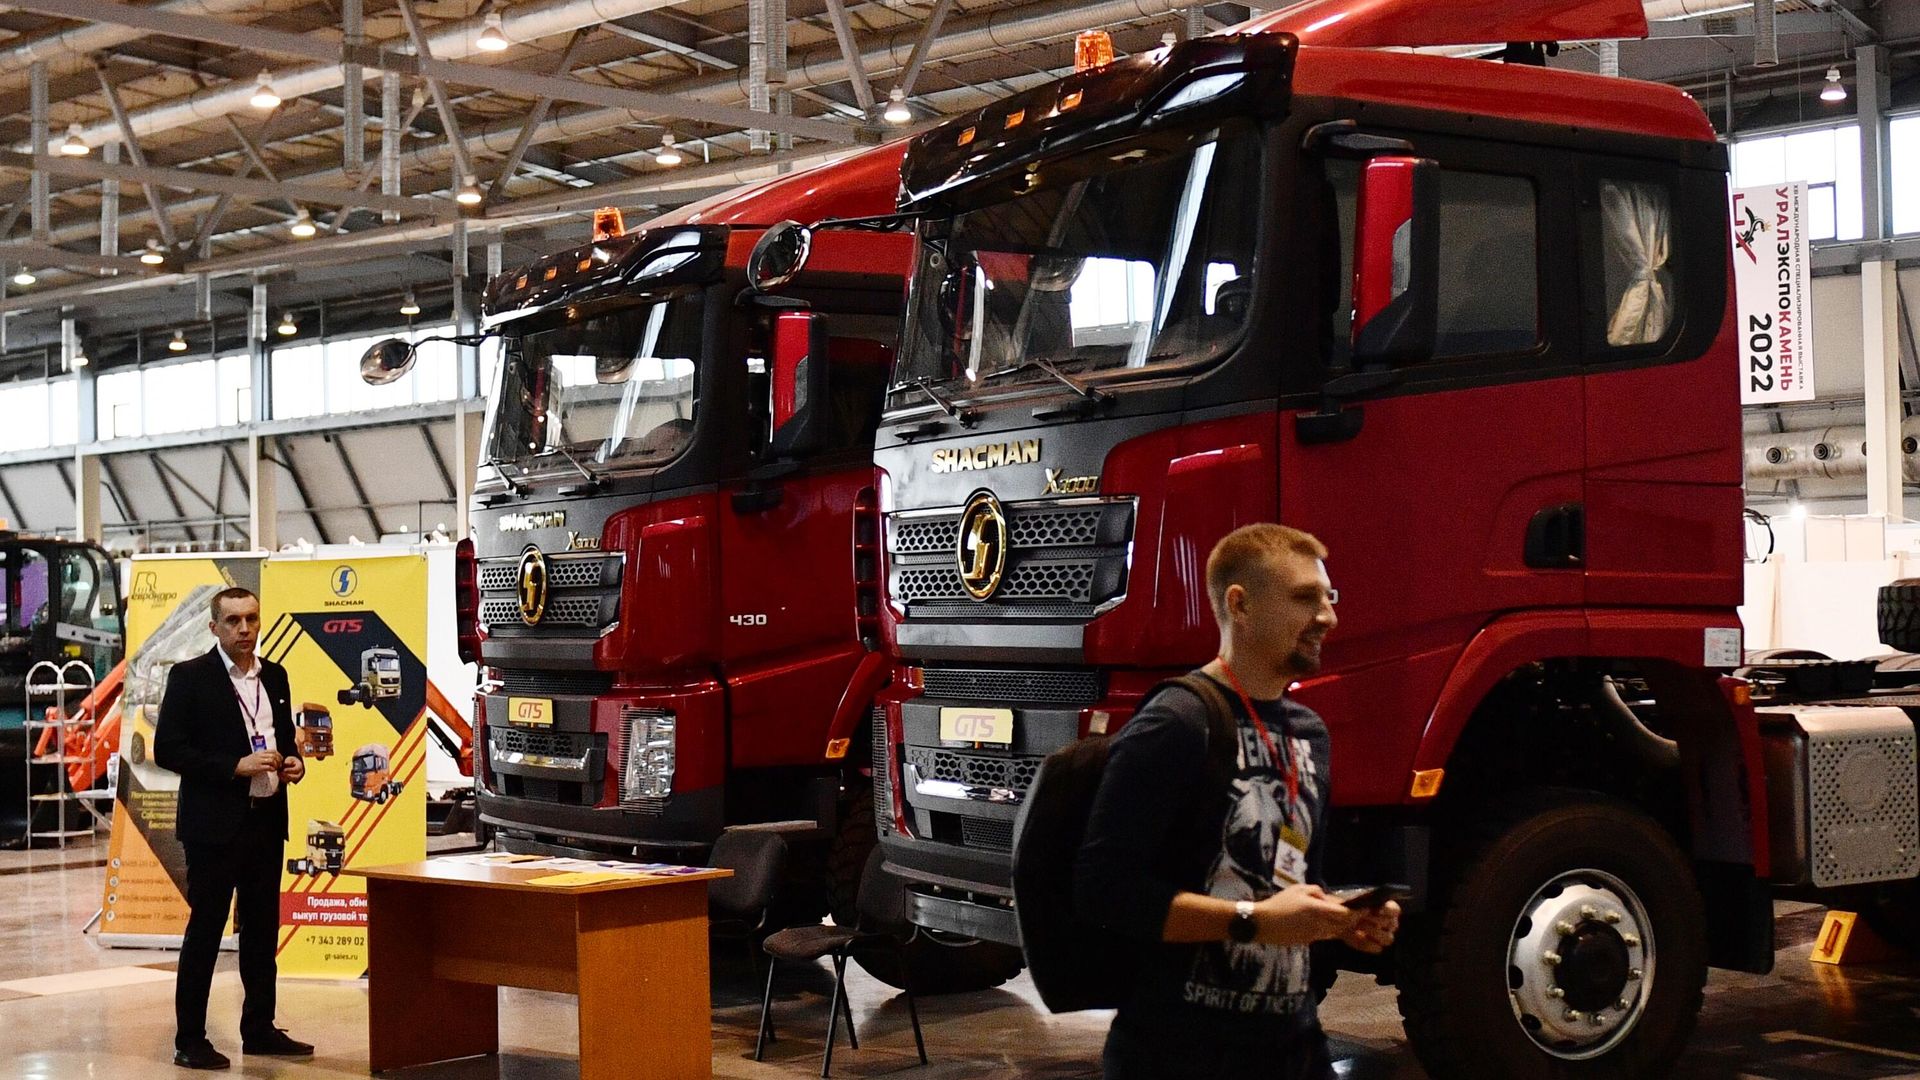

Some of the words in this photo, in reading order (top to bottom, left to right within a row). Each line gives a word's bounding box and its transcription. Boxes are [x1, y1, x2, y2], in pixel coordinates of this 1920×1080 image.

[1776, 186, 1793, 391] УРАЛЭКСПОКАМЕНЬ
[1795, 264, 1803, 350] СПЕЦИАЛИЗИРОВАННАЯ
[1749, 313, 1773, 393] 2022
[931, 438, 1042, 474] SHACMAN
[499, 510, 566, 531] SHACMAN
[323, 619, 364, 633] GTS
[730, 614, 767, 626] 430
[518, 702, 543, 719] GTS
[955, 714, 996, 738] GTS
[307, 896, 348, 908] Продажа,
[292, 911, 318, 922] выкуп
[319, 911, 357, 922] грузовой
[306, 935, 316, 945] +7
[318, 935, 334, 945] 343
[336, 936, 352, 945] 289
[354, 936, 365, 946] 02
